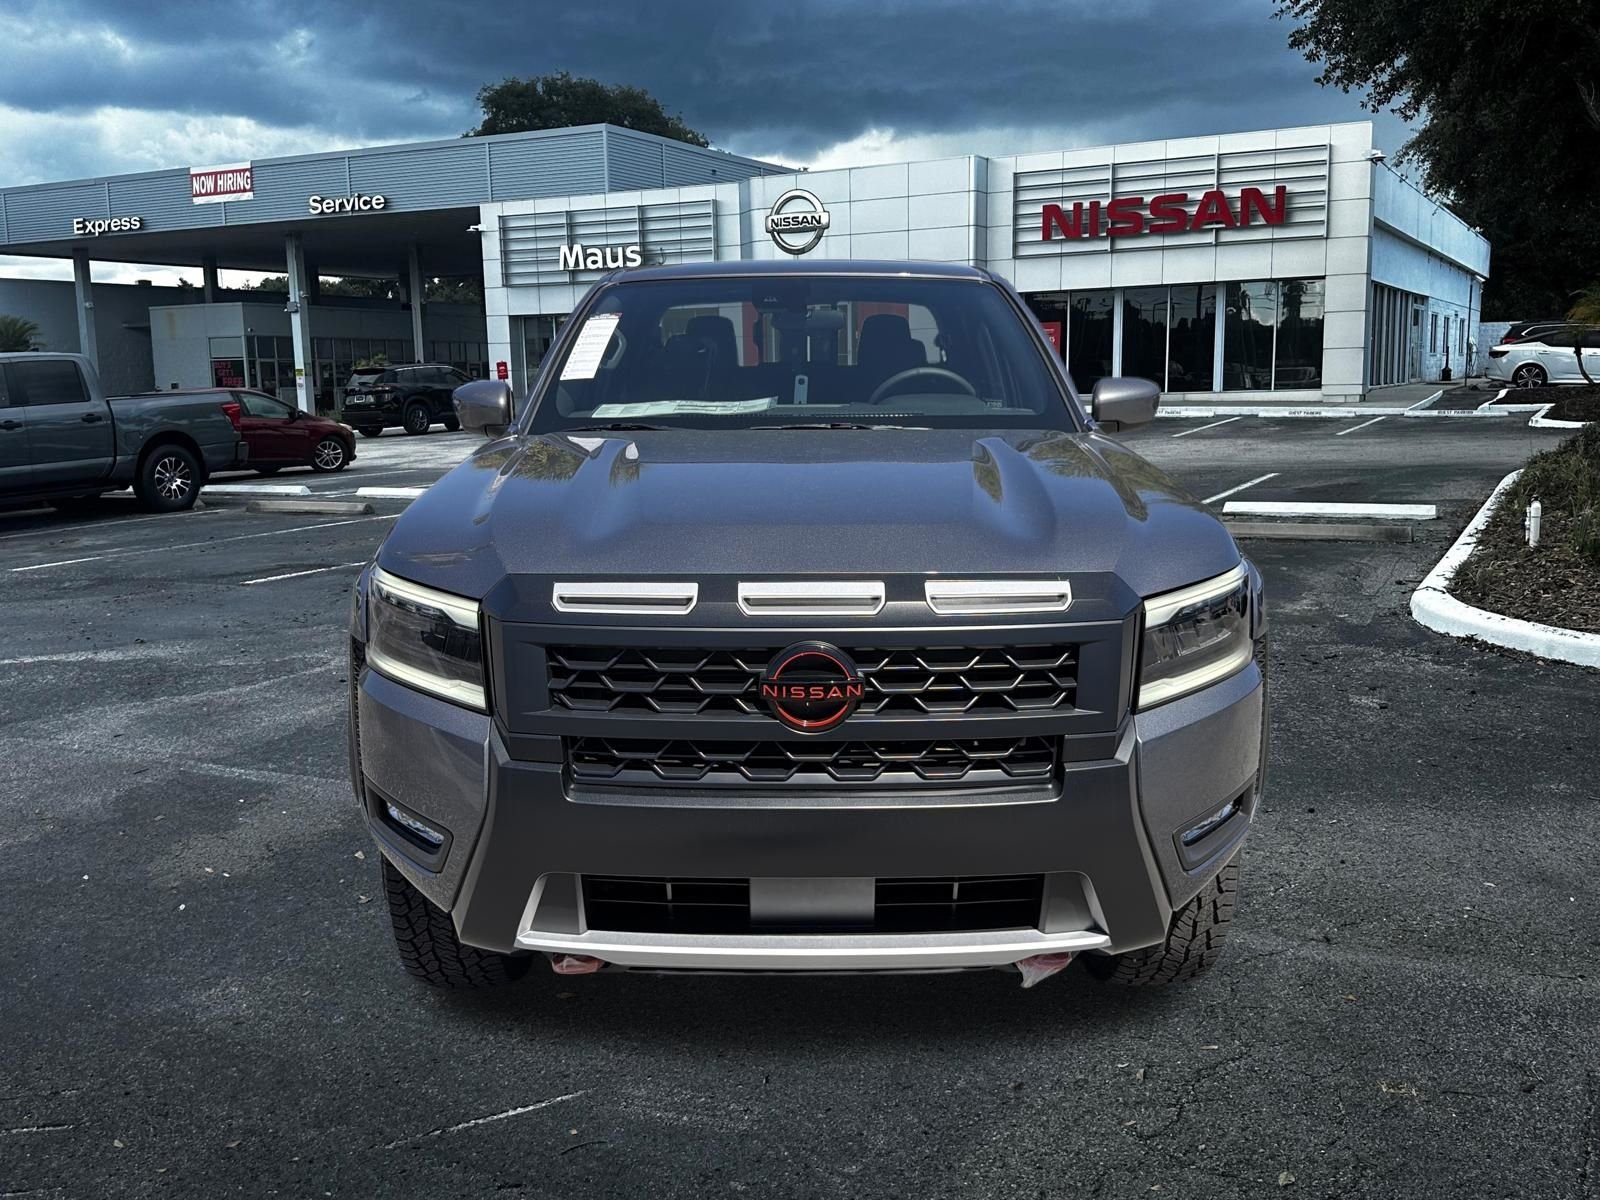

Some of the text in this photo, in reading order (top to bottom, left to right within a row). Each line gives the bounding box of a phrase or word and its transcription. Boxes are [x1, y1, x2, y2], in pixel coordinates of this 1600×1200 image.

[192, 170, 251, 195] NOW HIRING
[308, 192, 386, 215] Service
[1041, 185, 1287, 241] NISSAN
[73, 215, 141, 236] Express
[770, 214, 823, 230] NISSAN
[559, 244, 642, 271] Maus
[762, 684, 862, 699] NISSAN
